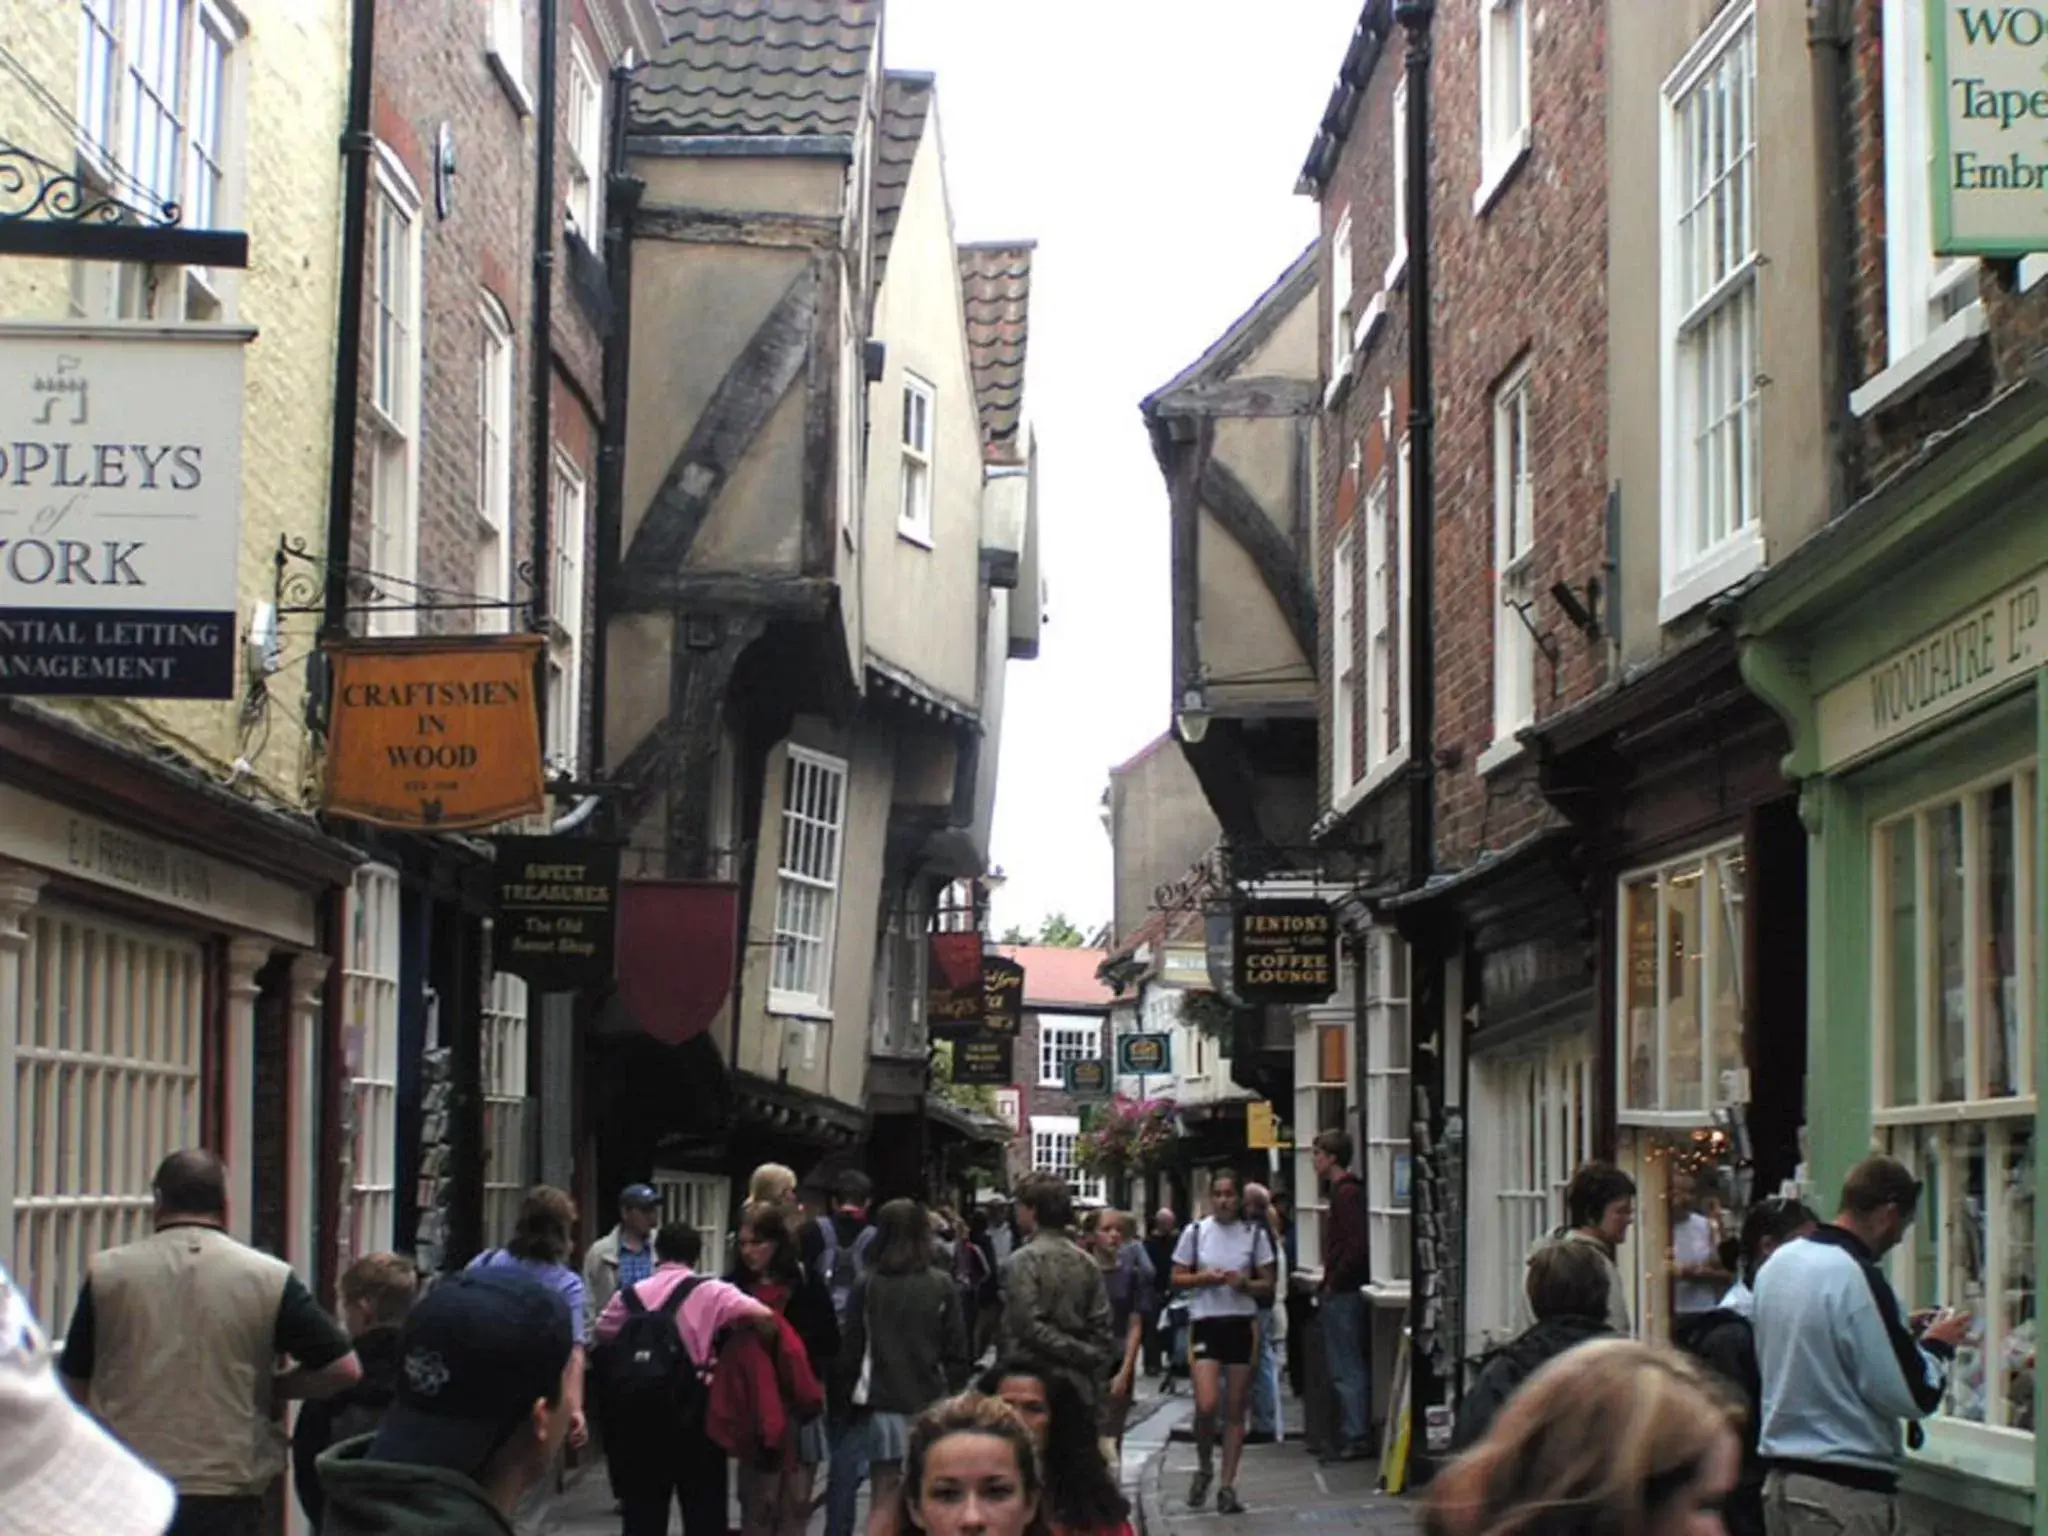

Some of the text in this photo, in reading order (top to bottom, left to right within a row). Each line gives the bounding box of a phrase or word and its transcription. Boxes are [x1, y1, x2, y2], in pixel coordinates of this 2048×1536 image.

[1958, 8, 2043, 45] WO
[1952, 78, 2048, 130] Tape
[0, 442, 202, 490] PLEYS
[28, 492, 90, 537] of
[0, 539, 146, 585] ORK
[96, 623, 219, 646] LETTING
[342, 682, 520, 708] CRAFTSMEN
[418, 714, 445, 734] IN
[387, 745, 477, 770] WOOD
[524, 863, 587, 881] SWEET
[501, 884, 609, 902] TREASURES
[525, 917, 551, 933] The
[1246, 954, 1328, 969] COFFEE
[1246, 970, 1328, 984] LOUNGE
